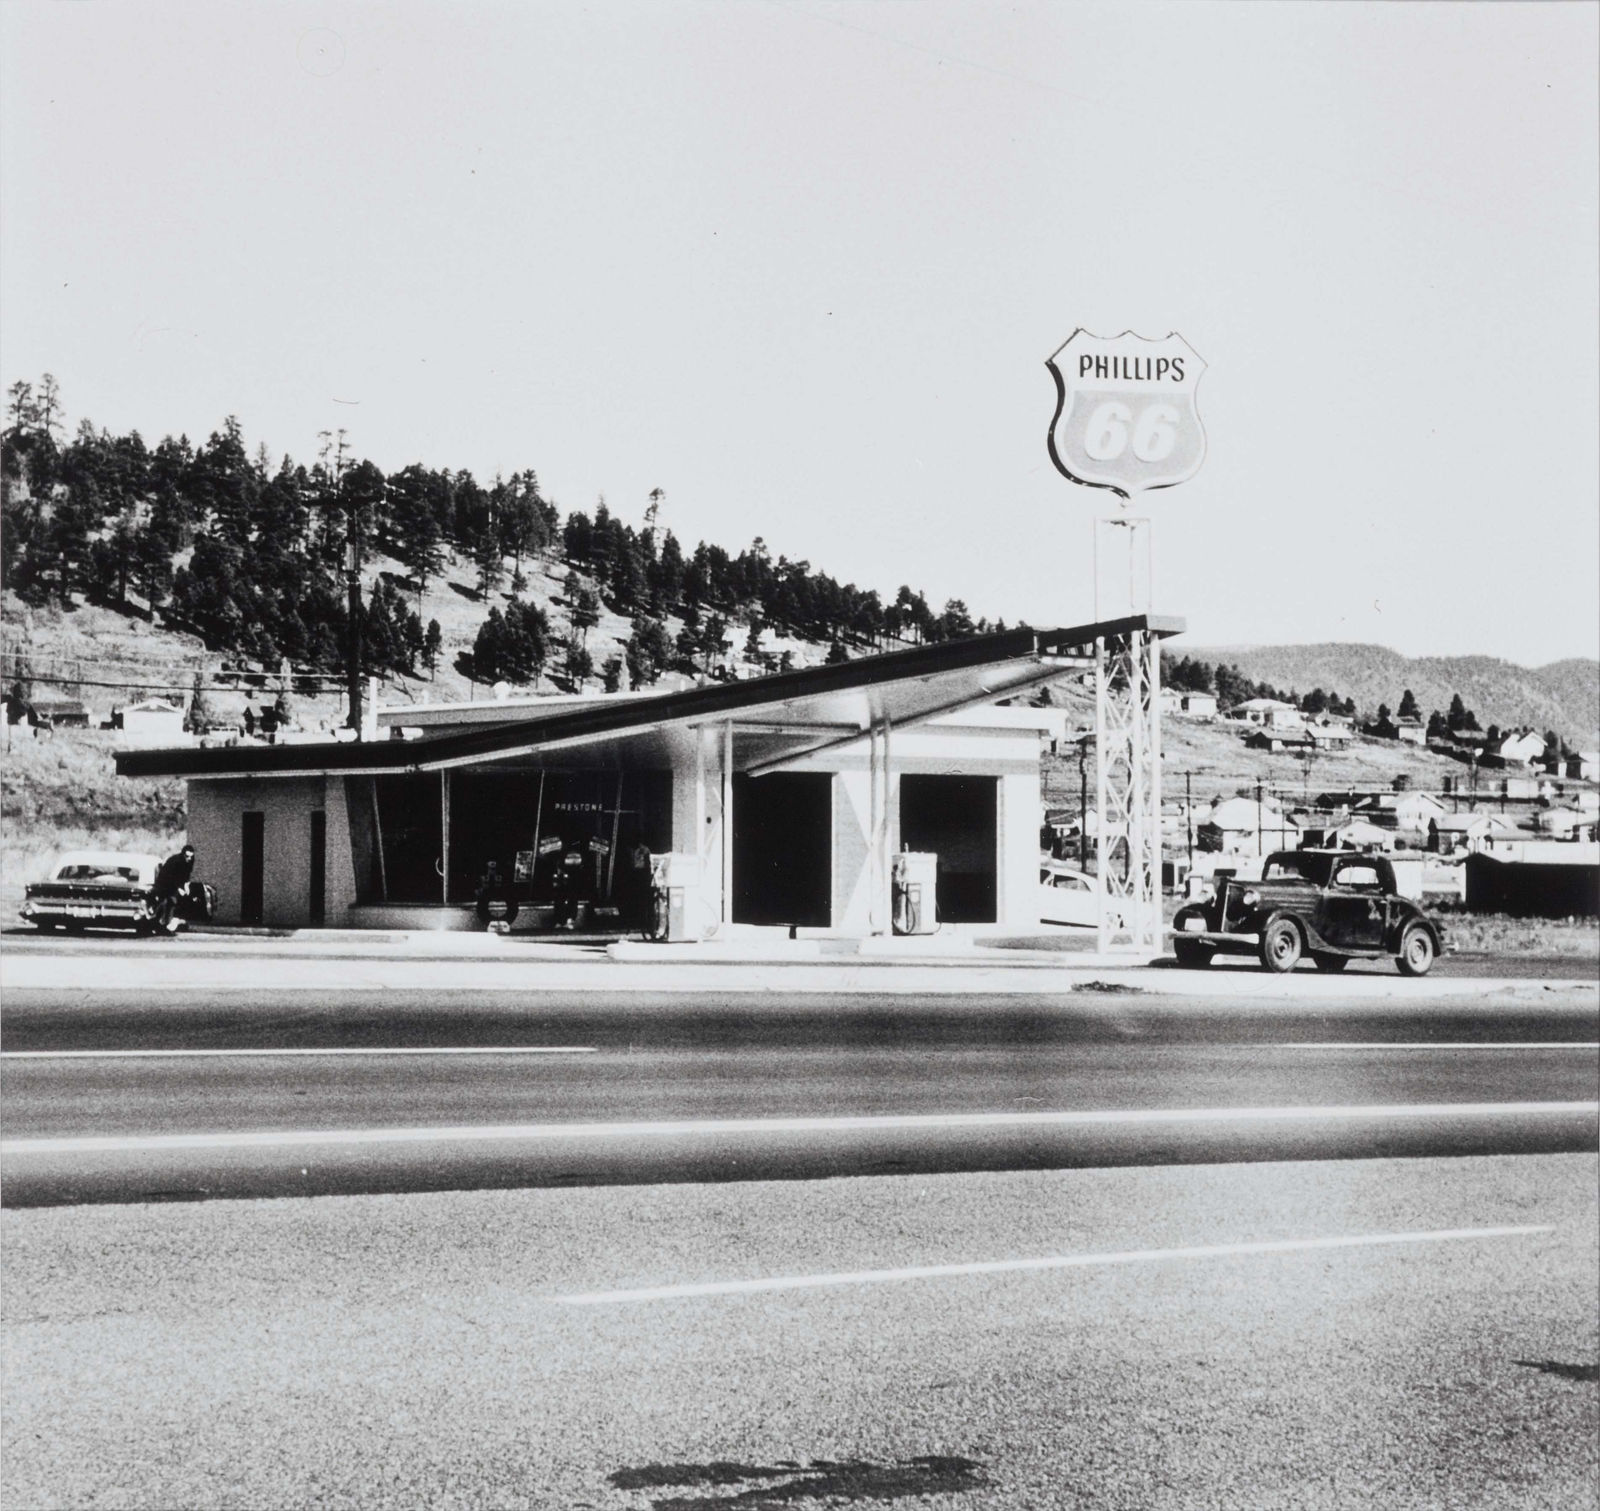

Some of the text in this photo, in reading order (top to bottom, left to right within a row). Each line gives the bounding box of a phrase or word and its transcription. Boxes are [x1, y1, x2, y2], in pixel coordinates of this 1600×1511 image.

[1079, 354, 1185, 382] PHILLIPS
[1085, 402, 1181, 463] 66
[555, 803, 603, 812] PRESTONE
